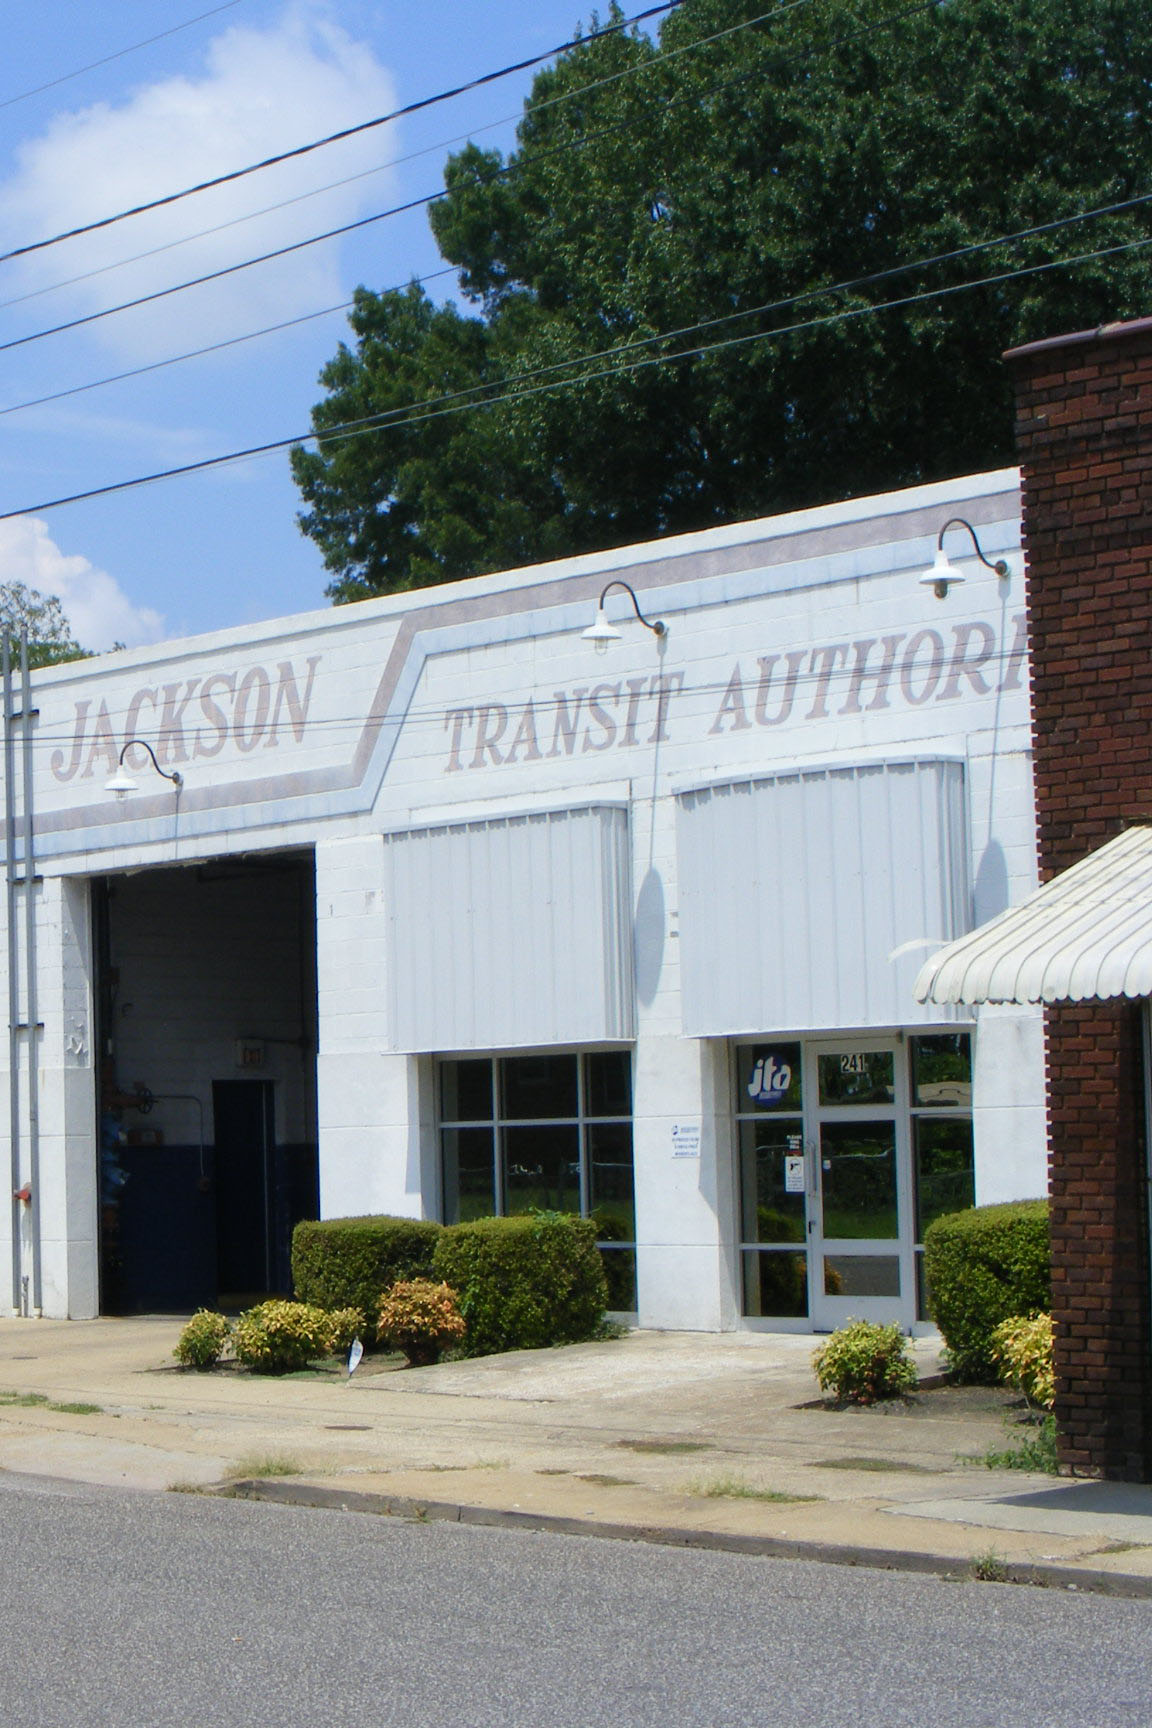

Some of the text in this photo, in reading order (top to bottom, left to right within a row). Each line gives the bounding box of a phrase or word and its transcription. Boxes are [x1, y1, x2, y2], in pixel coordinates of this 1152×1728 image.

[51, 656, 322, 783] JACKSON
[444, 671, 685, 772] TRANSIT
[748, 1056, 791, 1097] jta
[841, 1054, 864, 1073] 241
